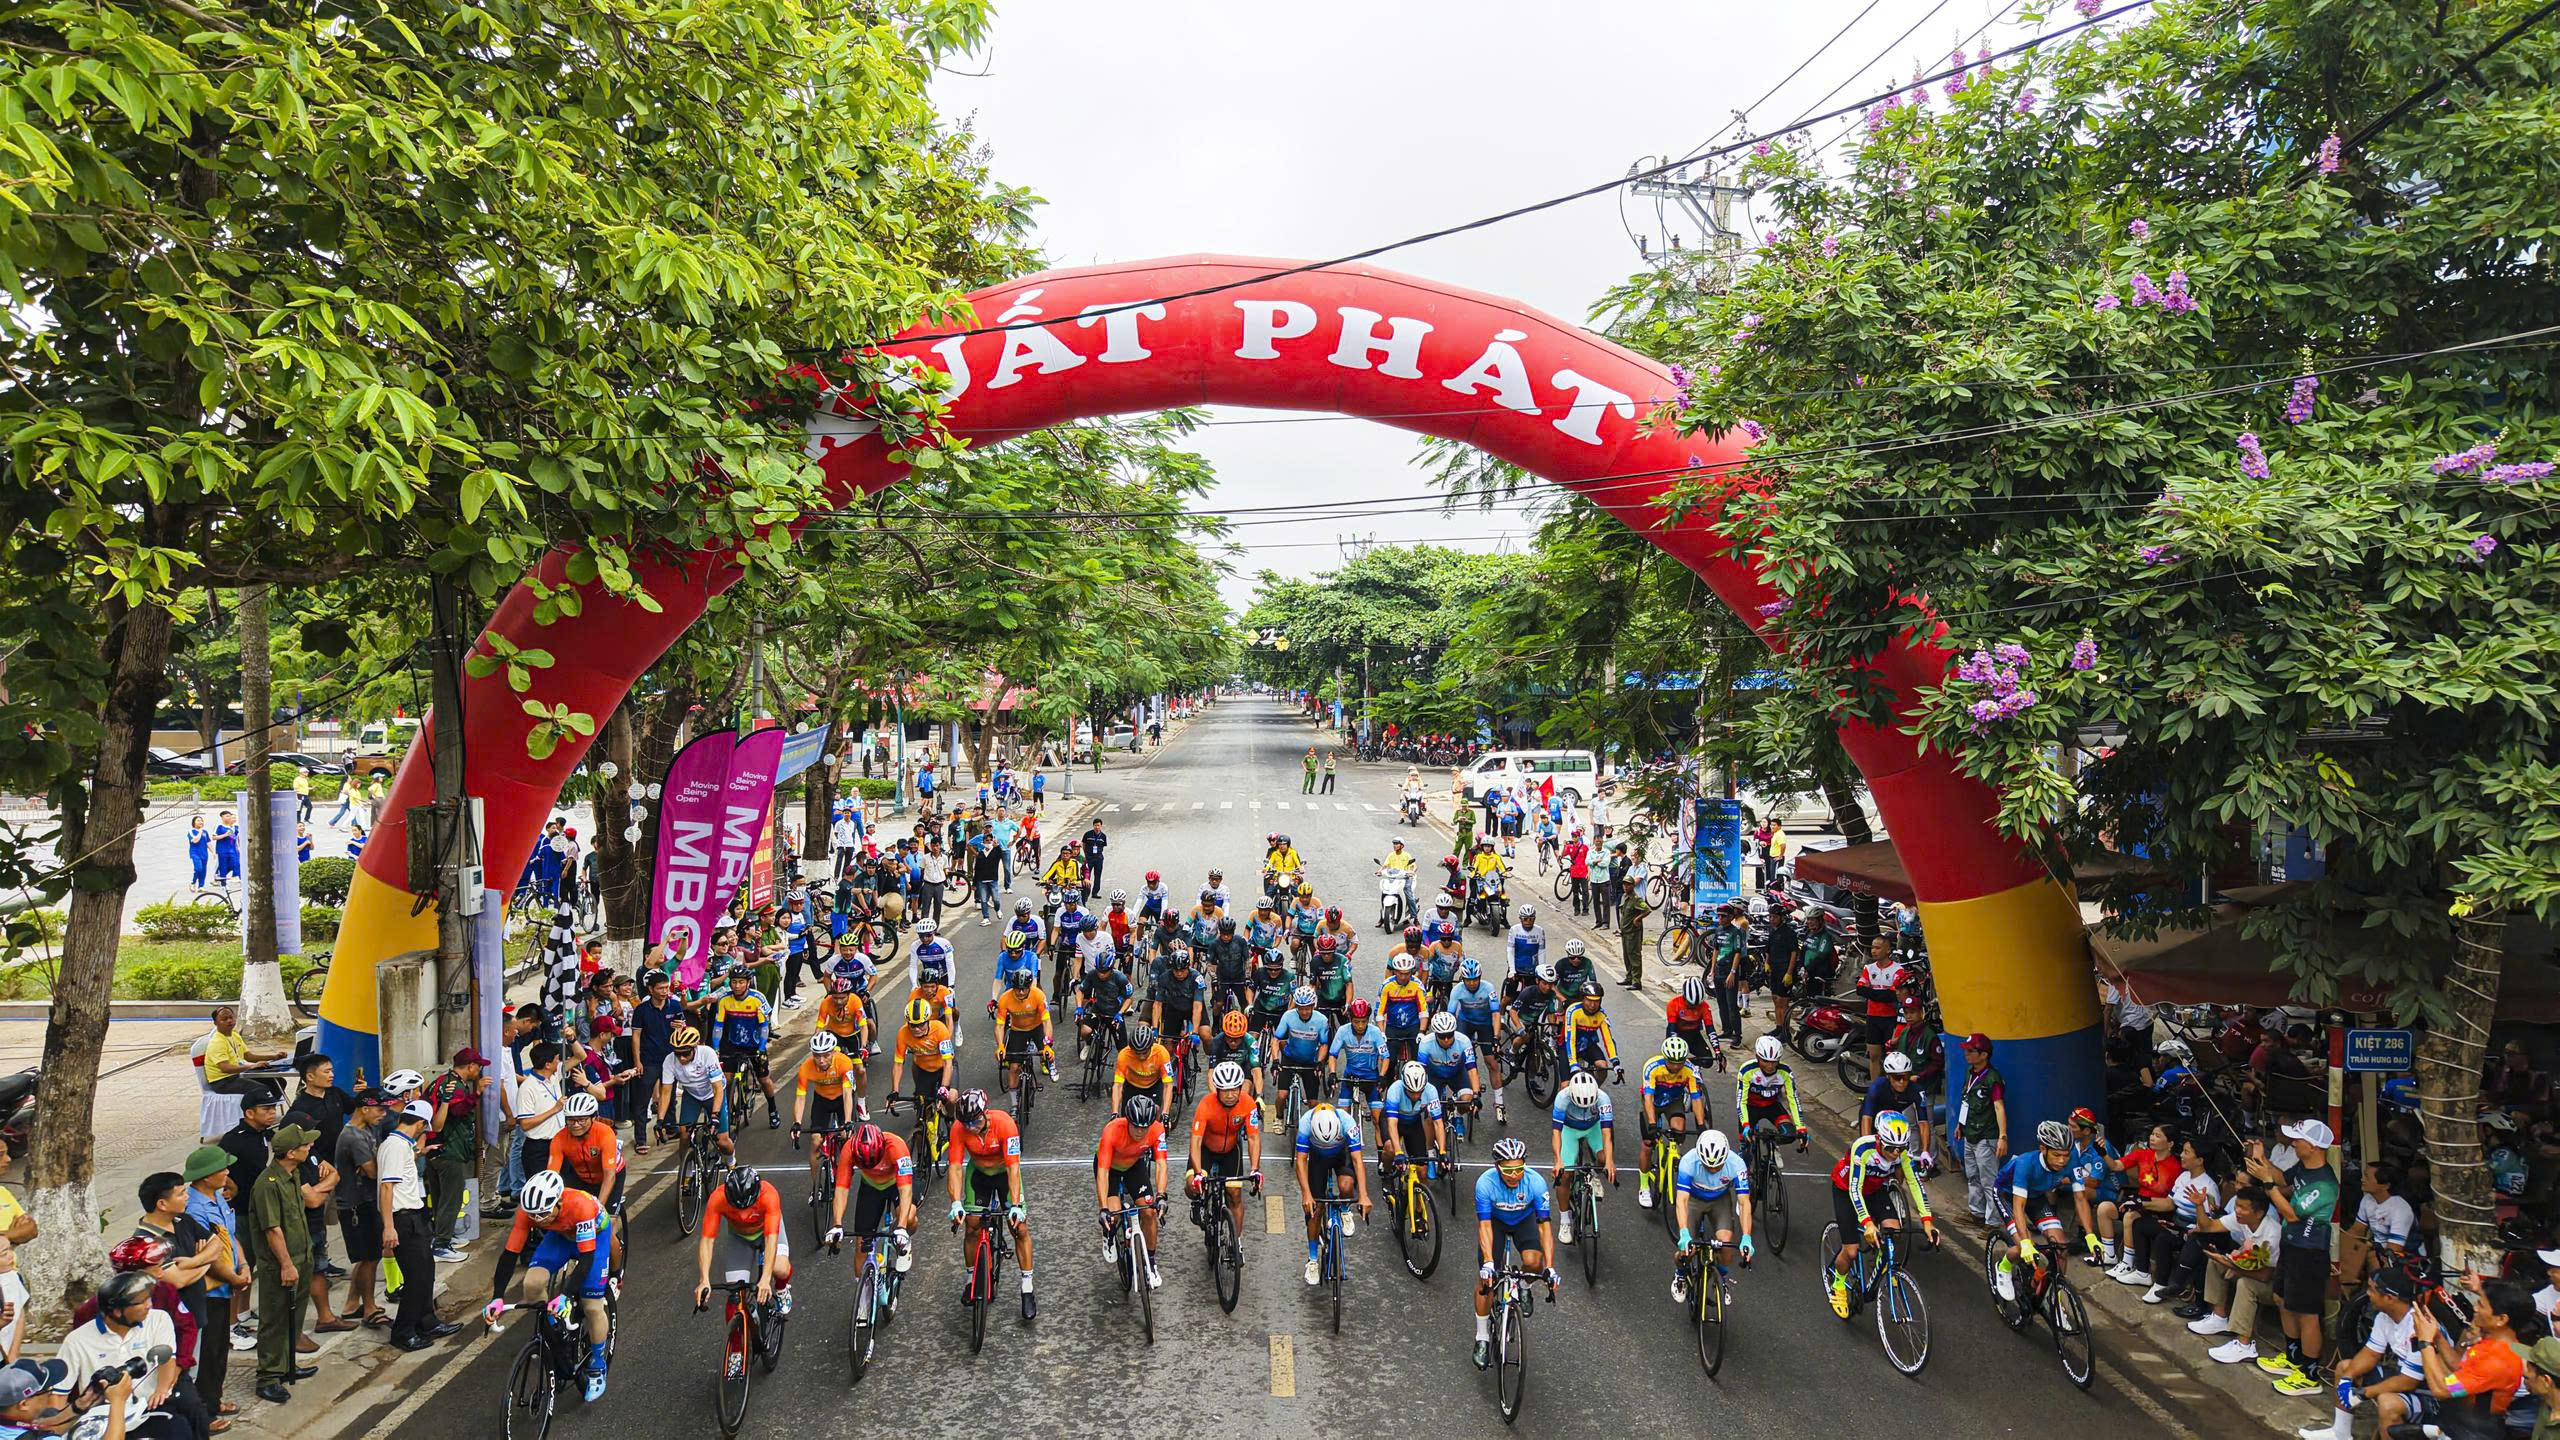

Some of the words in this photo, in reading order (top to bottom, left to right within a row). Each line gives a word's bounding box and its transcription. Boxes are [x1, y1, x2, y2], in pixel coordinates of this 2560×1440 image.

[1233, 299, 1636, 446] PHÁT
[735, 777, 757, 787] Being
[742, 771, 768, 782] Moving
[690, 780, 720, 791] Moving
[729, 782, 749, 791] Open
[683, 788, 708, 797] Being
[675, 794, 700, 803] Open
[660, 820, 714, 961] MBO
[2355, 1034, 2382, 1051] KIỆT
